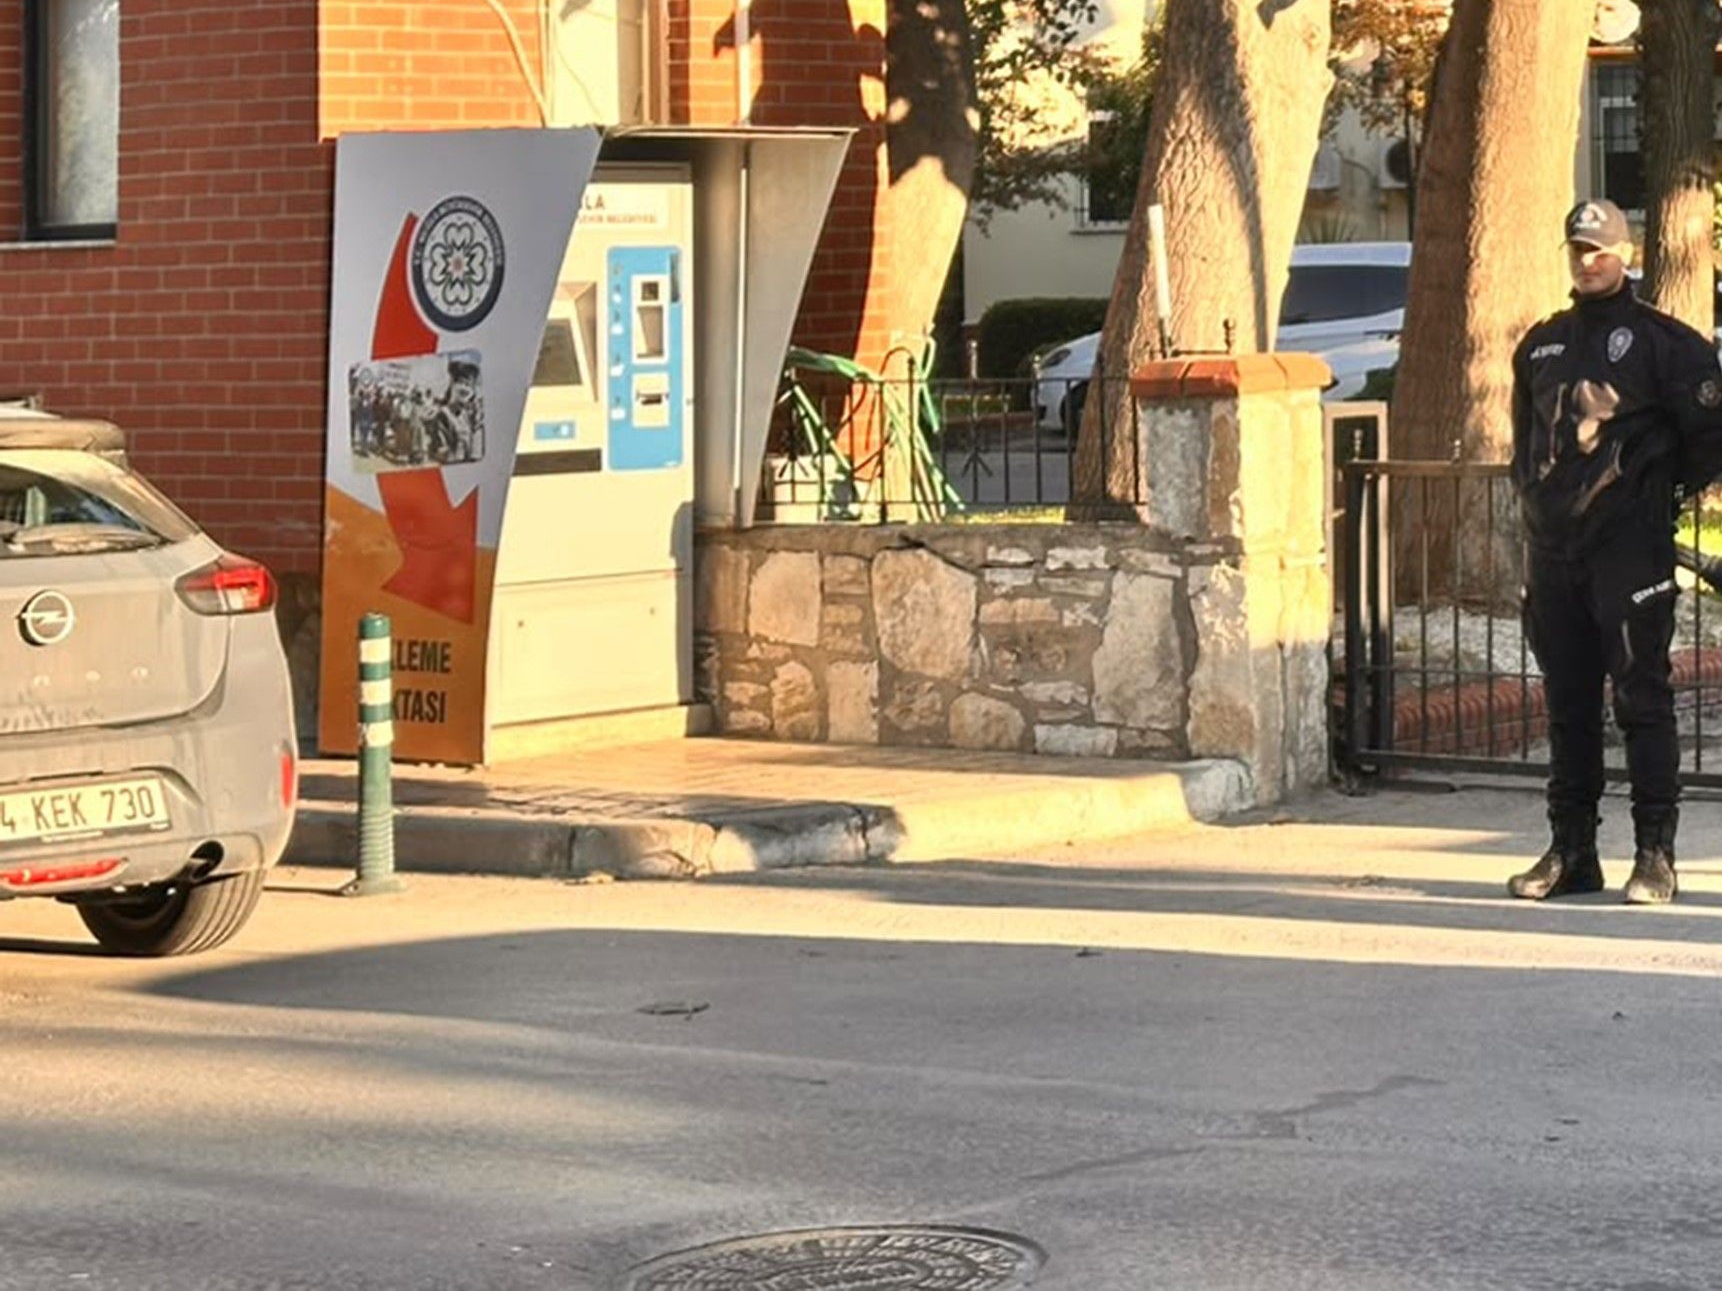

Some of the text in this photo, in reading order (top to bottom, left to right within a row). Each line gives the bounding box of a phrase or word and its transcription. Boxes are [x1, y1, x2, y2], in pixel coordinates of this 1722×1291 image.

[391, 639, 452, 673] LEME
[31, 791, 87, 830] KEK
[100, 786, 155, 823] 730
